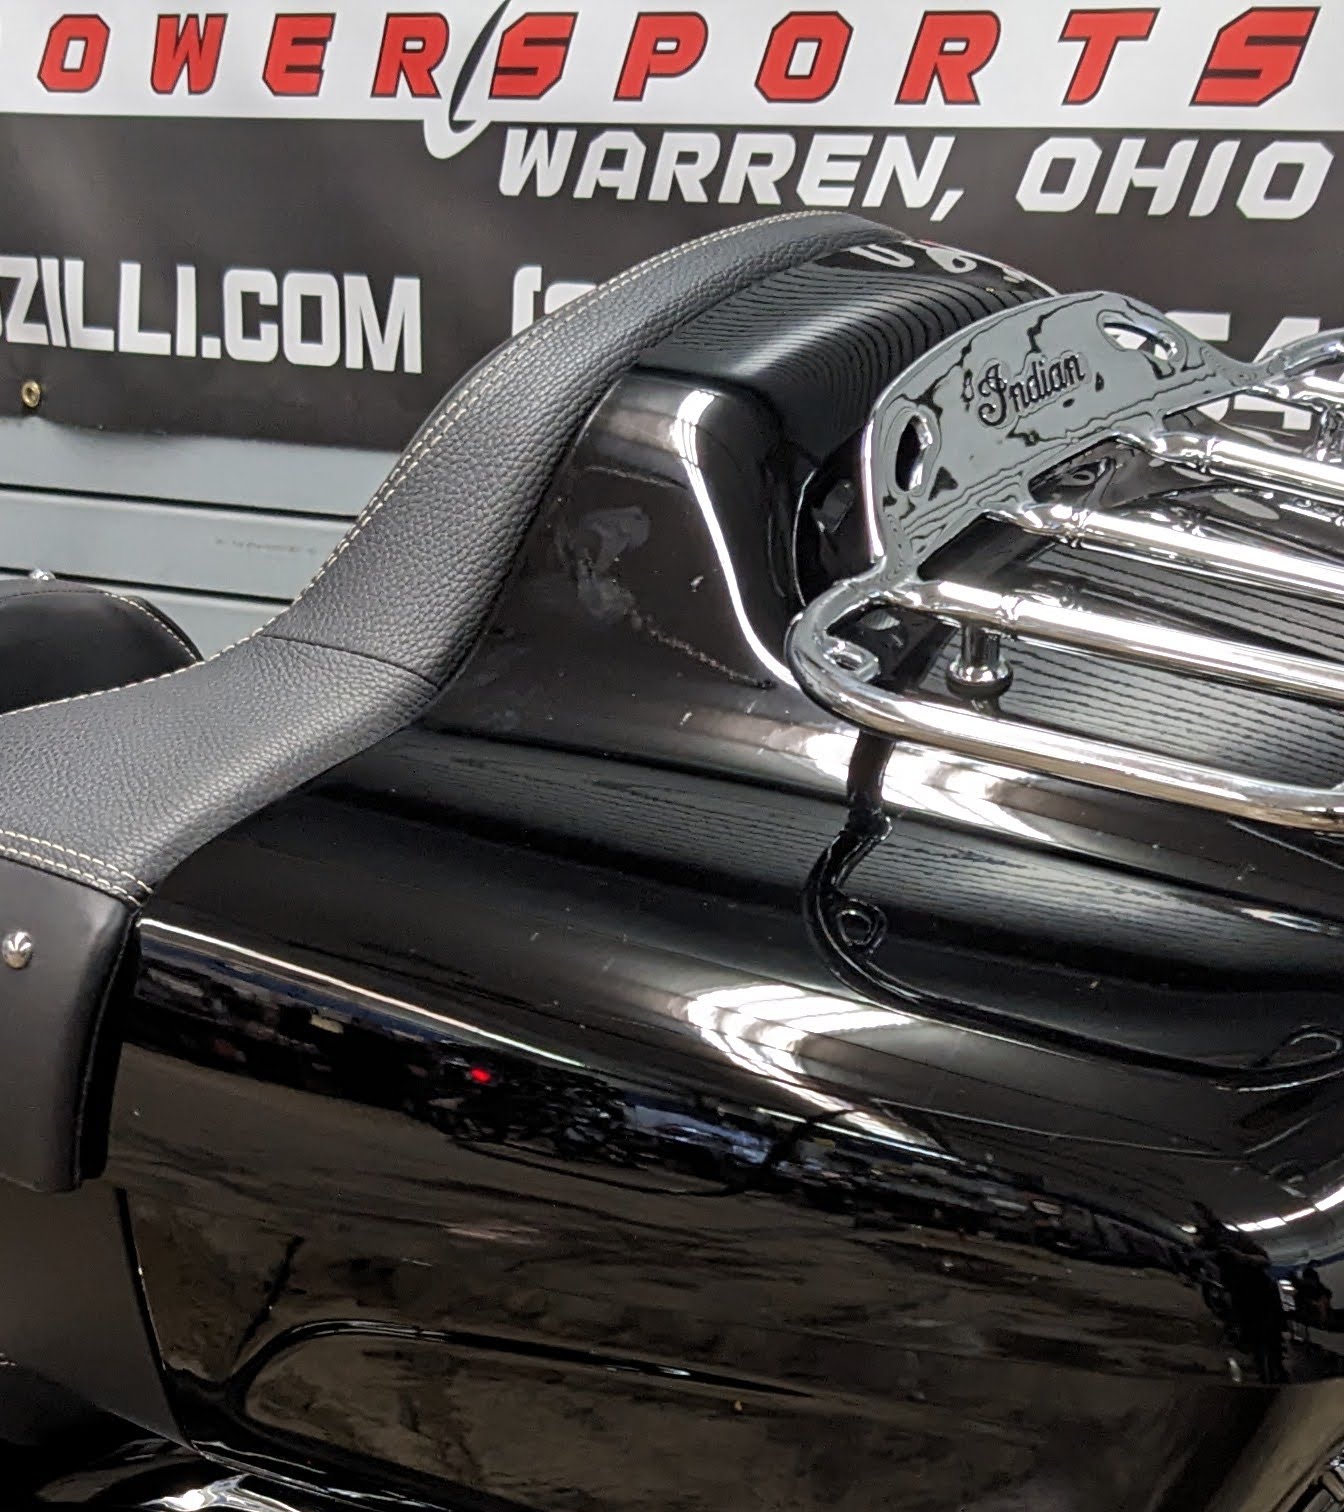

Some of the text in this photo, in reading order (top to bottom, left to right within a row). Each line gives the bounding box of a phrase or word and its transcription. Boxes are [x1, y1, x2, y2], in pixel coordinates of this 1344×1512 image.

[498, 127, 1335, 222] WARREN, OHIO
[977, 354, 1086, 427] Indian
